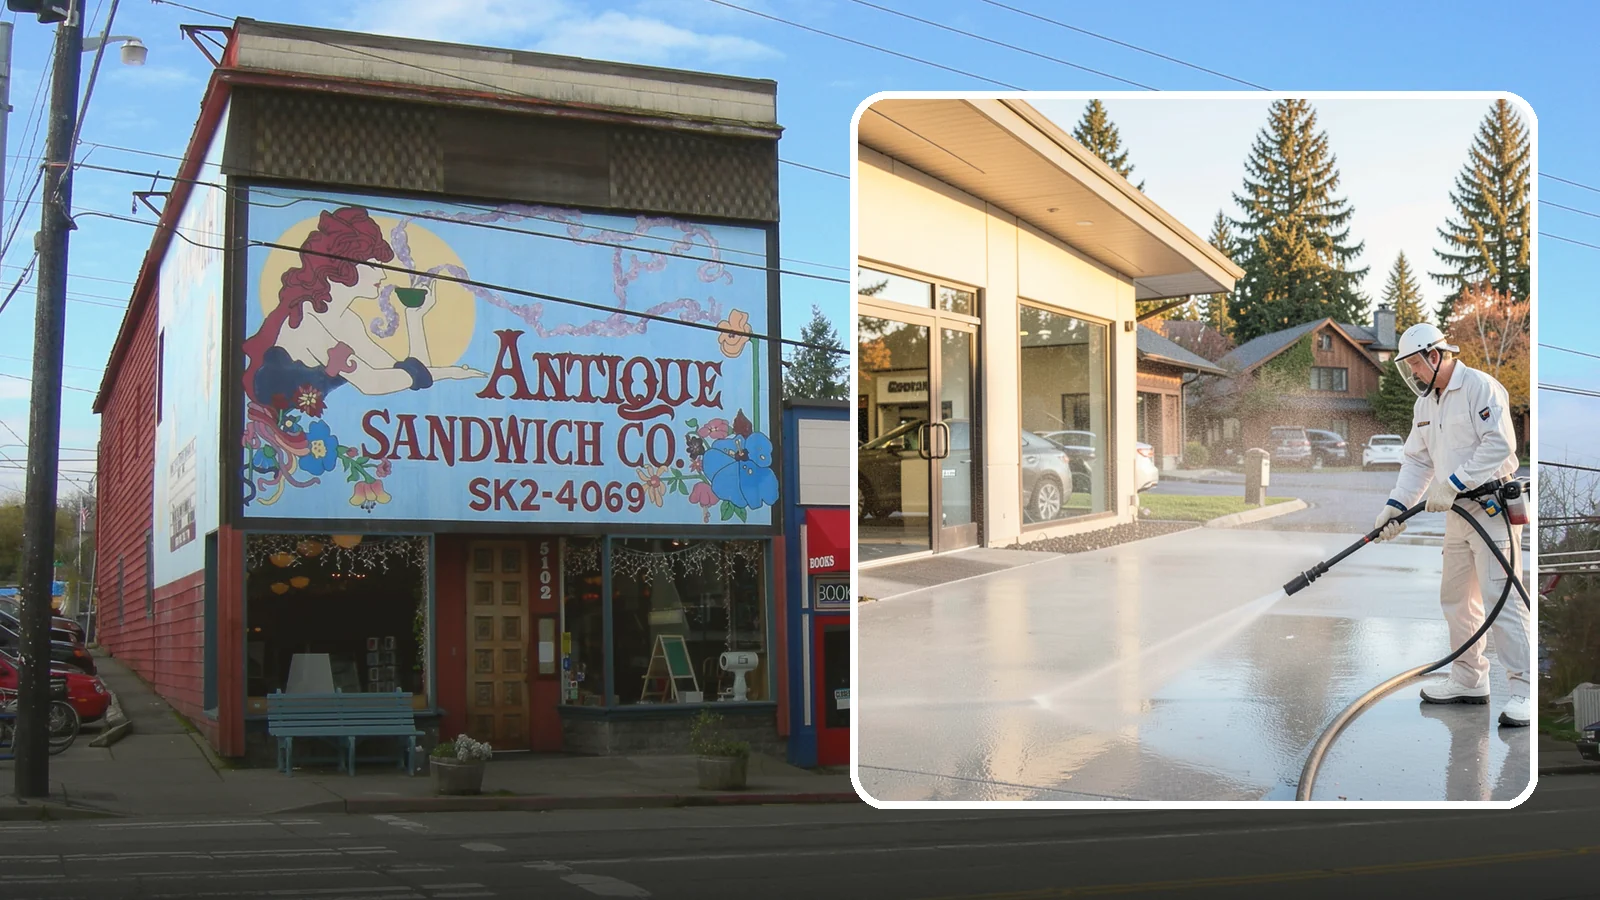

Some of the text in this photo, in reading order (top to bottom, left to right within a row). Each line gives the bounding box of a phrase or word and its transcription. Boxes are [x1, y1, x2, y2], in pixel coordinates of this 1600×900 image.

[475, 328, 723, 421] ANTIQUE
[361, 408, 685, 469] SANDWICH CO.
[468, 476, 646, 513] SK2-4069
[540, 541, 552, 600] 5102
[809, 555, 835, 569] BOOKS
